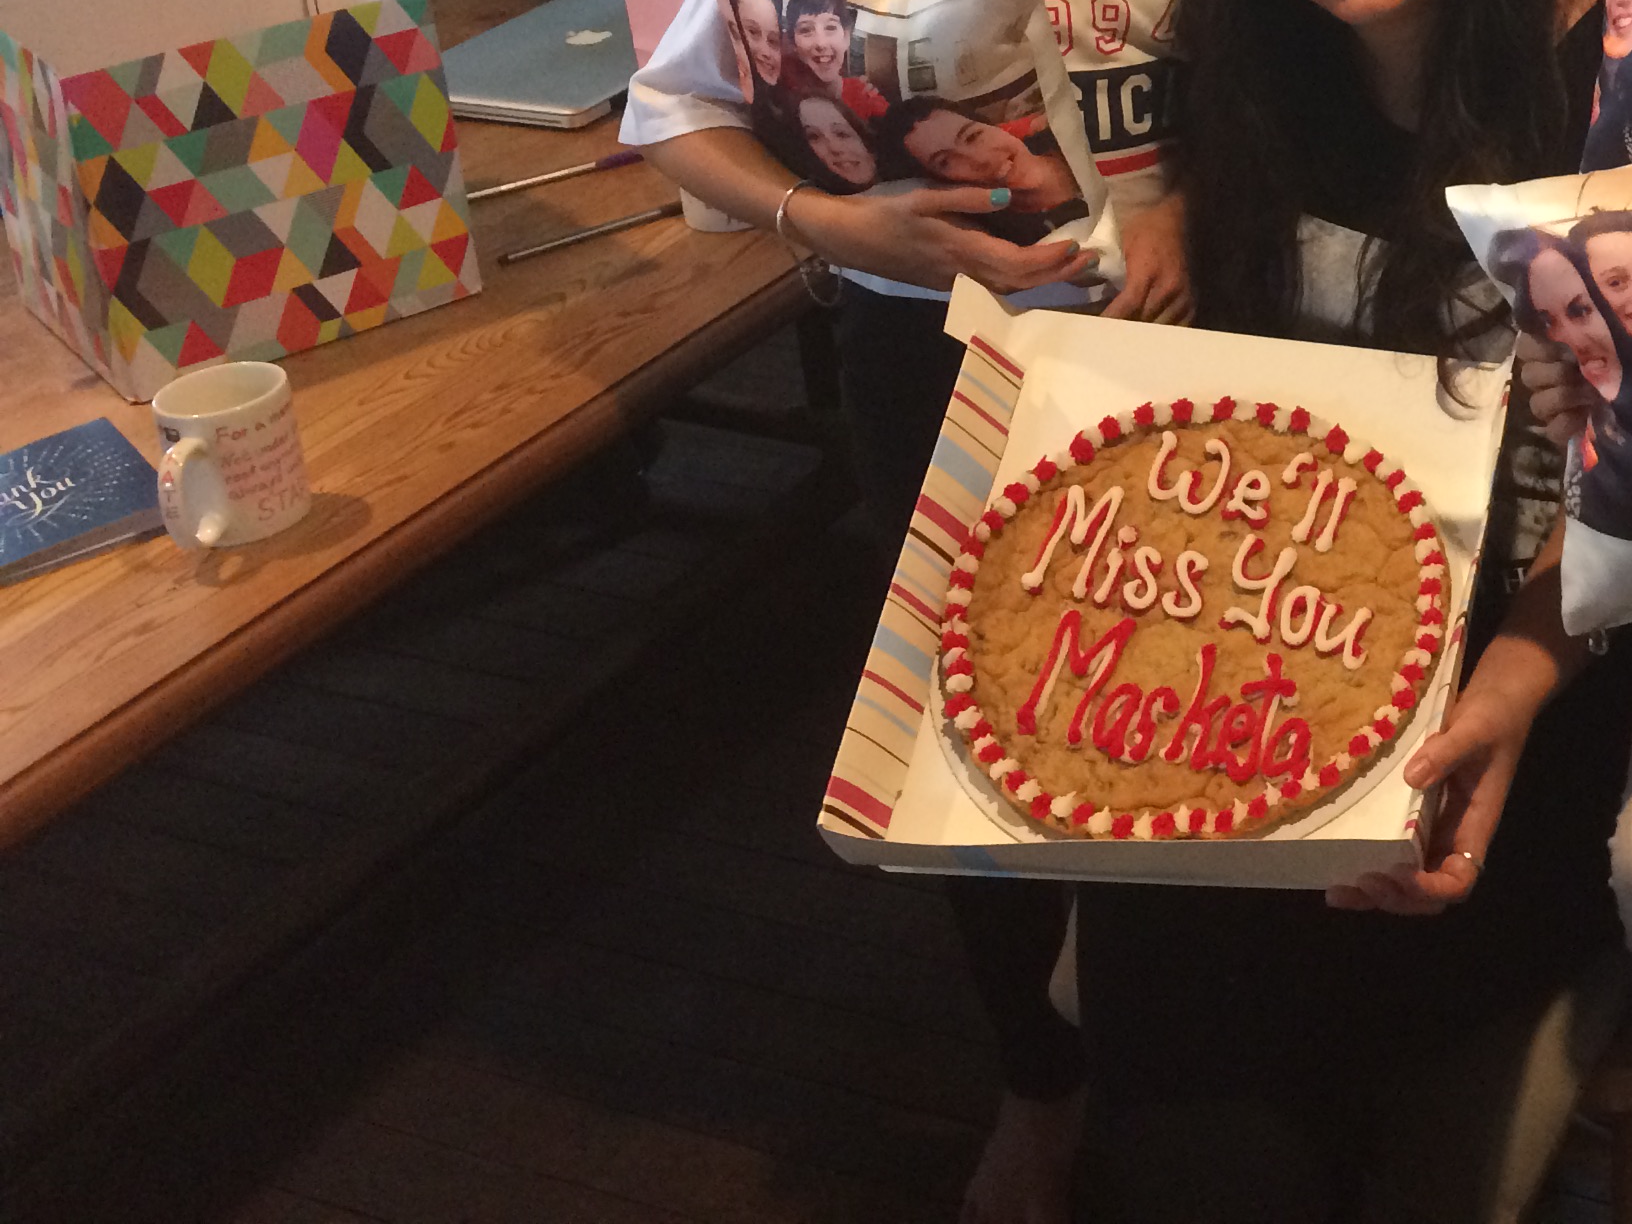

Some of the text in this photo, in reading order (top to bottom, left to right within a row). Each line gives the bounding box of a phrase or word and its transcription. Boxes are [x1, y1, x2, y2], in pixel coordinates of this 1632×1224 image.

[215, 426, 248, 444] For
[1148, 430, 1359, 552] We'll
[1021, 484, 1373, 671] Miss You
[1016, 609, 1317, 786] Marketa
